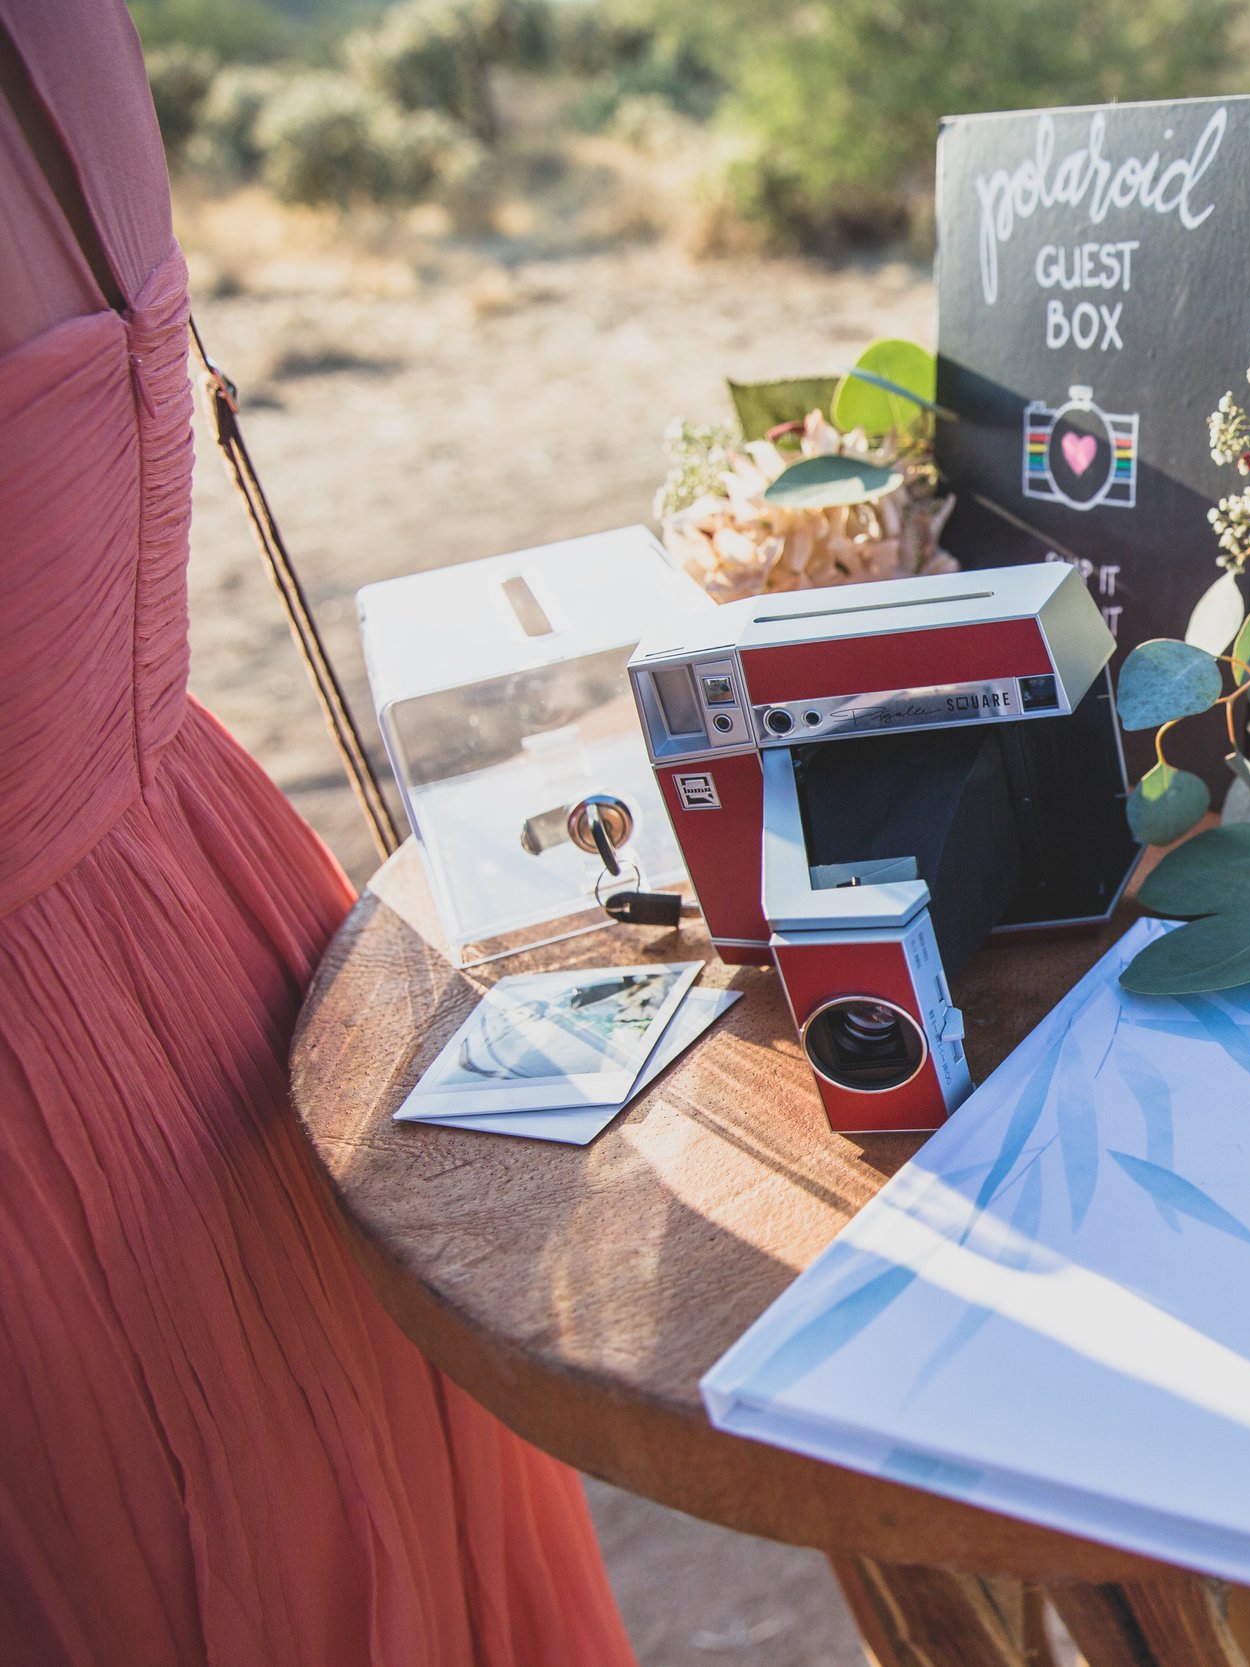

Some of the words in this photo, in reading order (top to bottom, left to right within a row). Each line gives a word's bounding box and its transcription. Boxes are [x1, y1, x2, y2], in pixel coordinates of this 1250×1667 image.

[975, 107, 1226, 306] polaroid
[1036, 240, 1139, 293] GUEST
[1046, 300, 1124, 351] BOX
[1099, 564, 1121, 597] IT
[946, 692, 1011, 712] SQUARE
